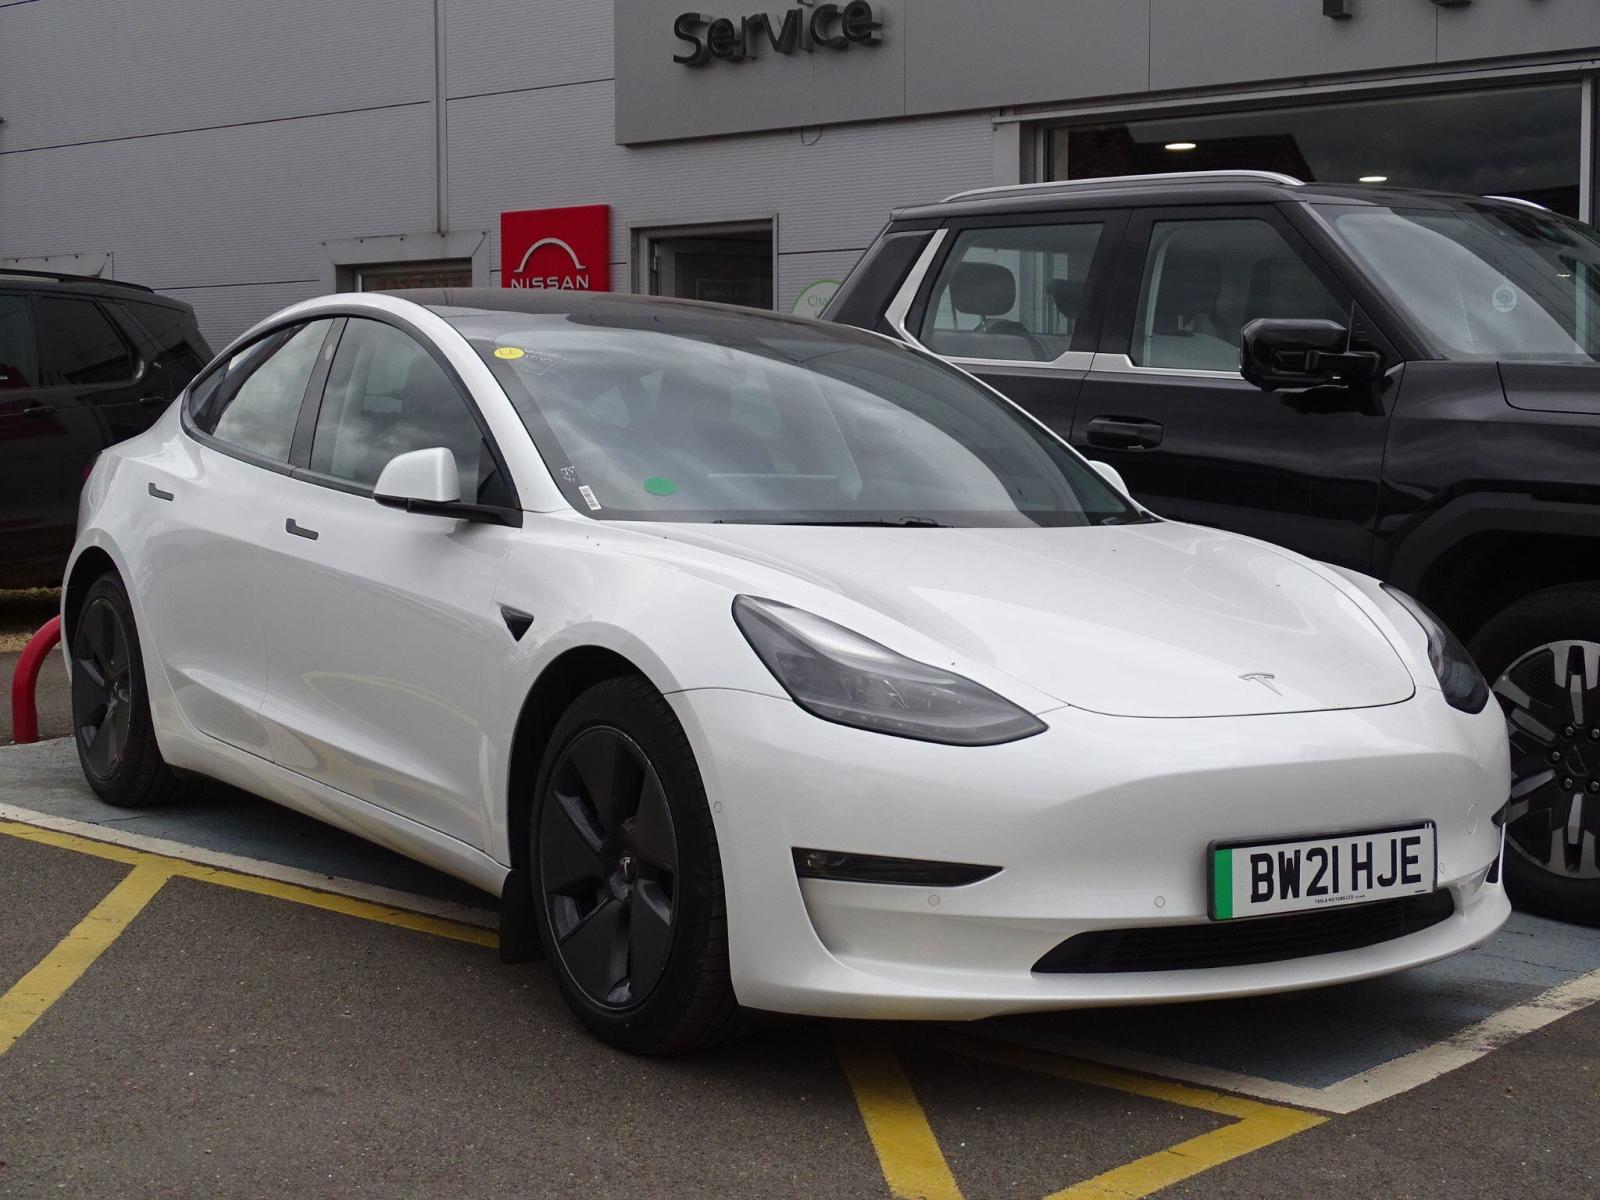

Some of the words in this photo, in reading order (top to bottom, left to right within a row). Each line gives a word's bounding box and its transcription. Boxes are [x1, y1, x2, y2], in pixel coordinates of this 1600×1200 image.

[673, 0, 881, 64] Service
[511, 275, 589, 289] NISSAN
[1251, 845, 1339, 903] BW21
[1352, 836, 1421, 892] HJE
